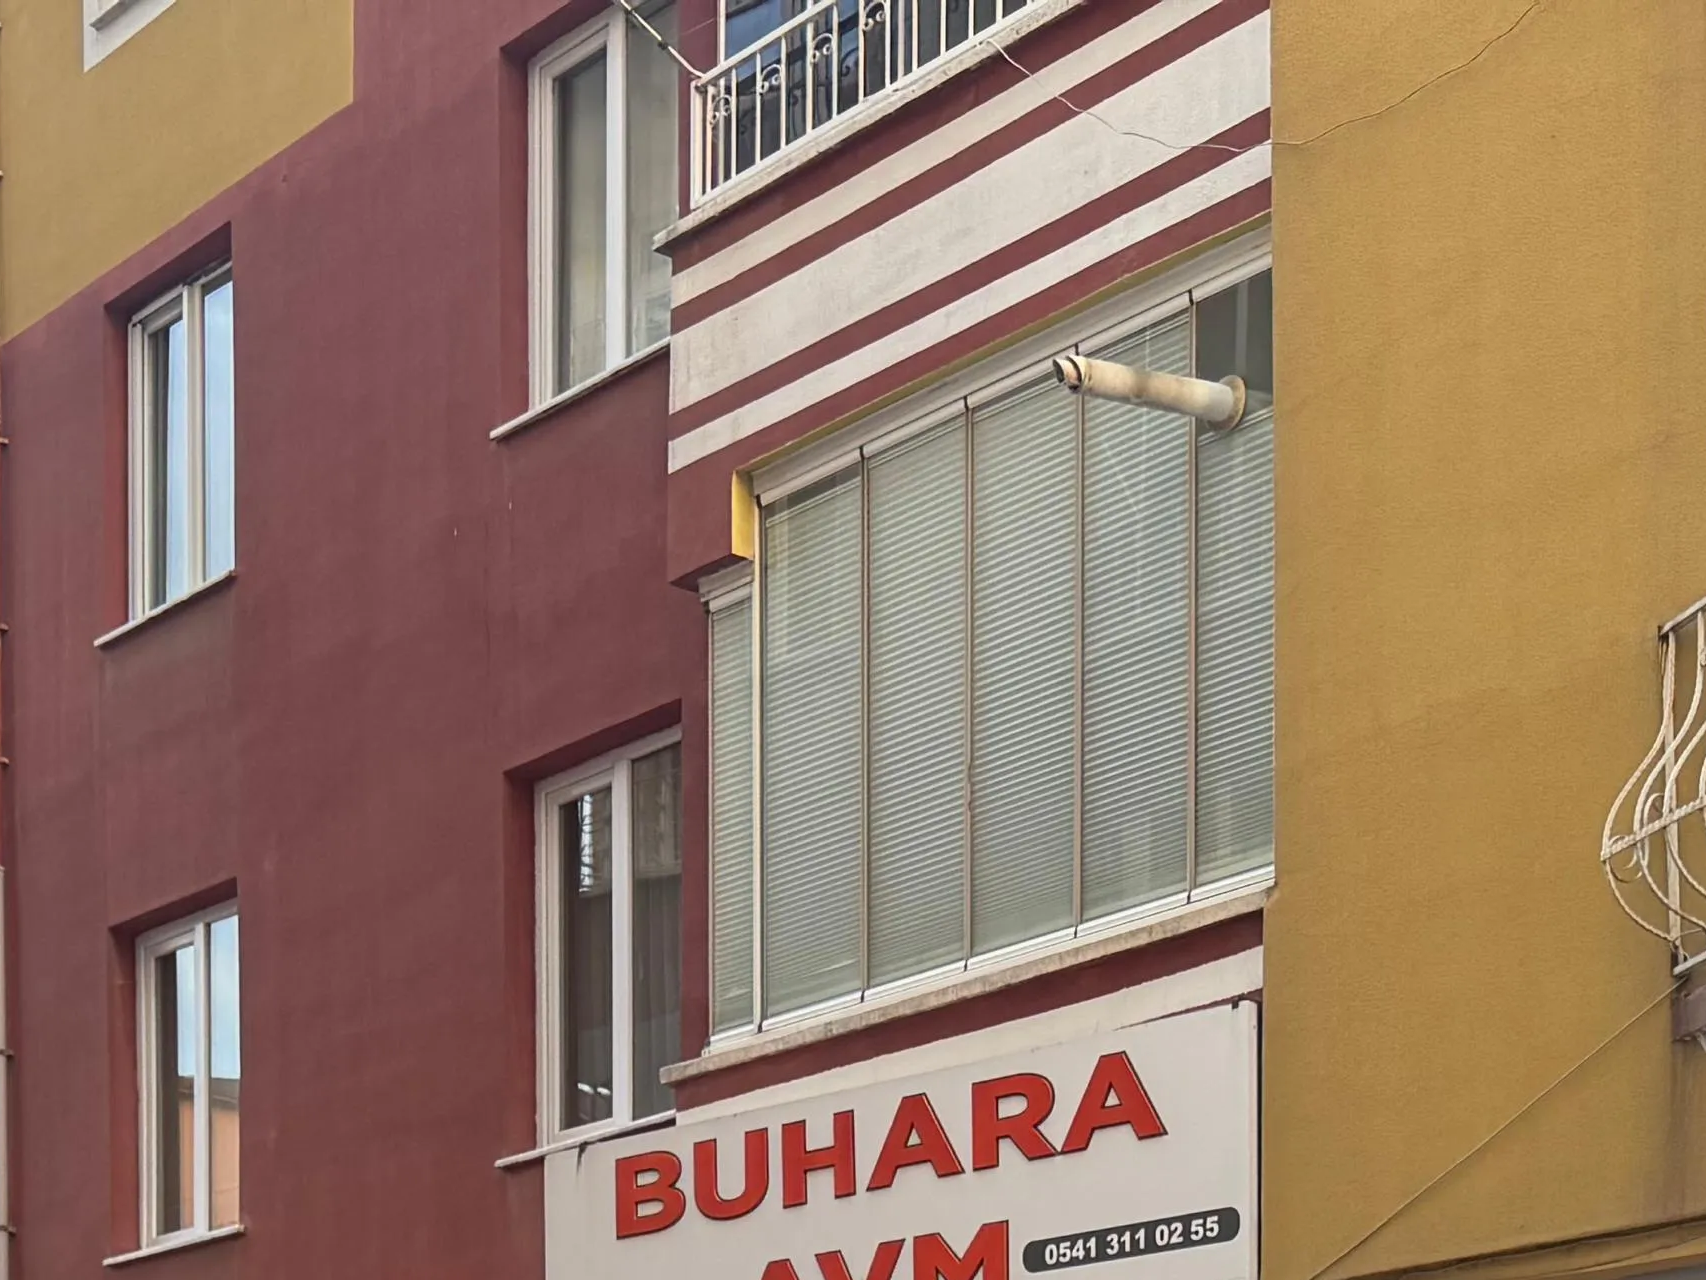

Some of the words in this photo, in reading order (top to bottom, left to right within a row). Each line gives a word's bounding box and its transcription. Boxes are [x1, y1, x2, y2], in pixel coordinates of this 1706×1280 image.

[615, 1050, 1168, 1240] BUHARA
[1044, 1235, 1097, 1266] 0541
[1105, 1228, 1146, 1256] 311
[1155, 1222, 1184, 1247] 02
[1190, 1215, 1220, 1241] 55
